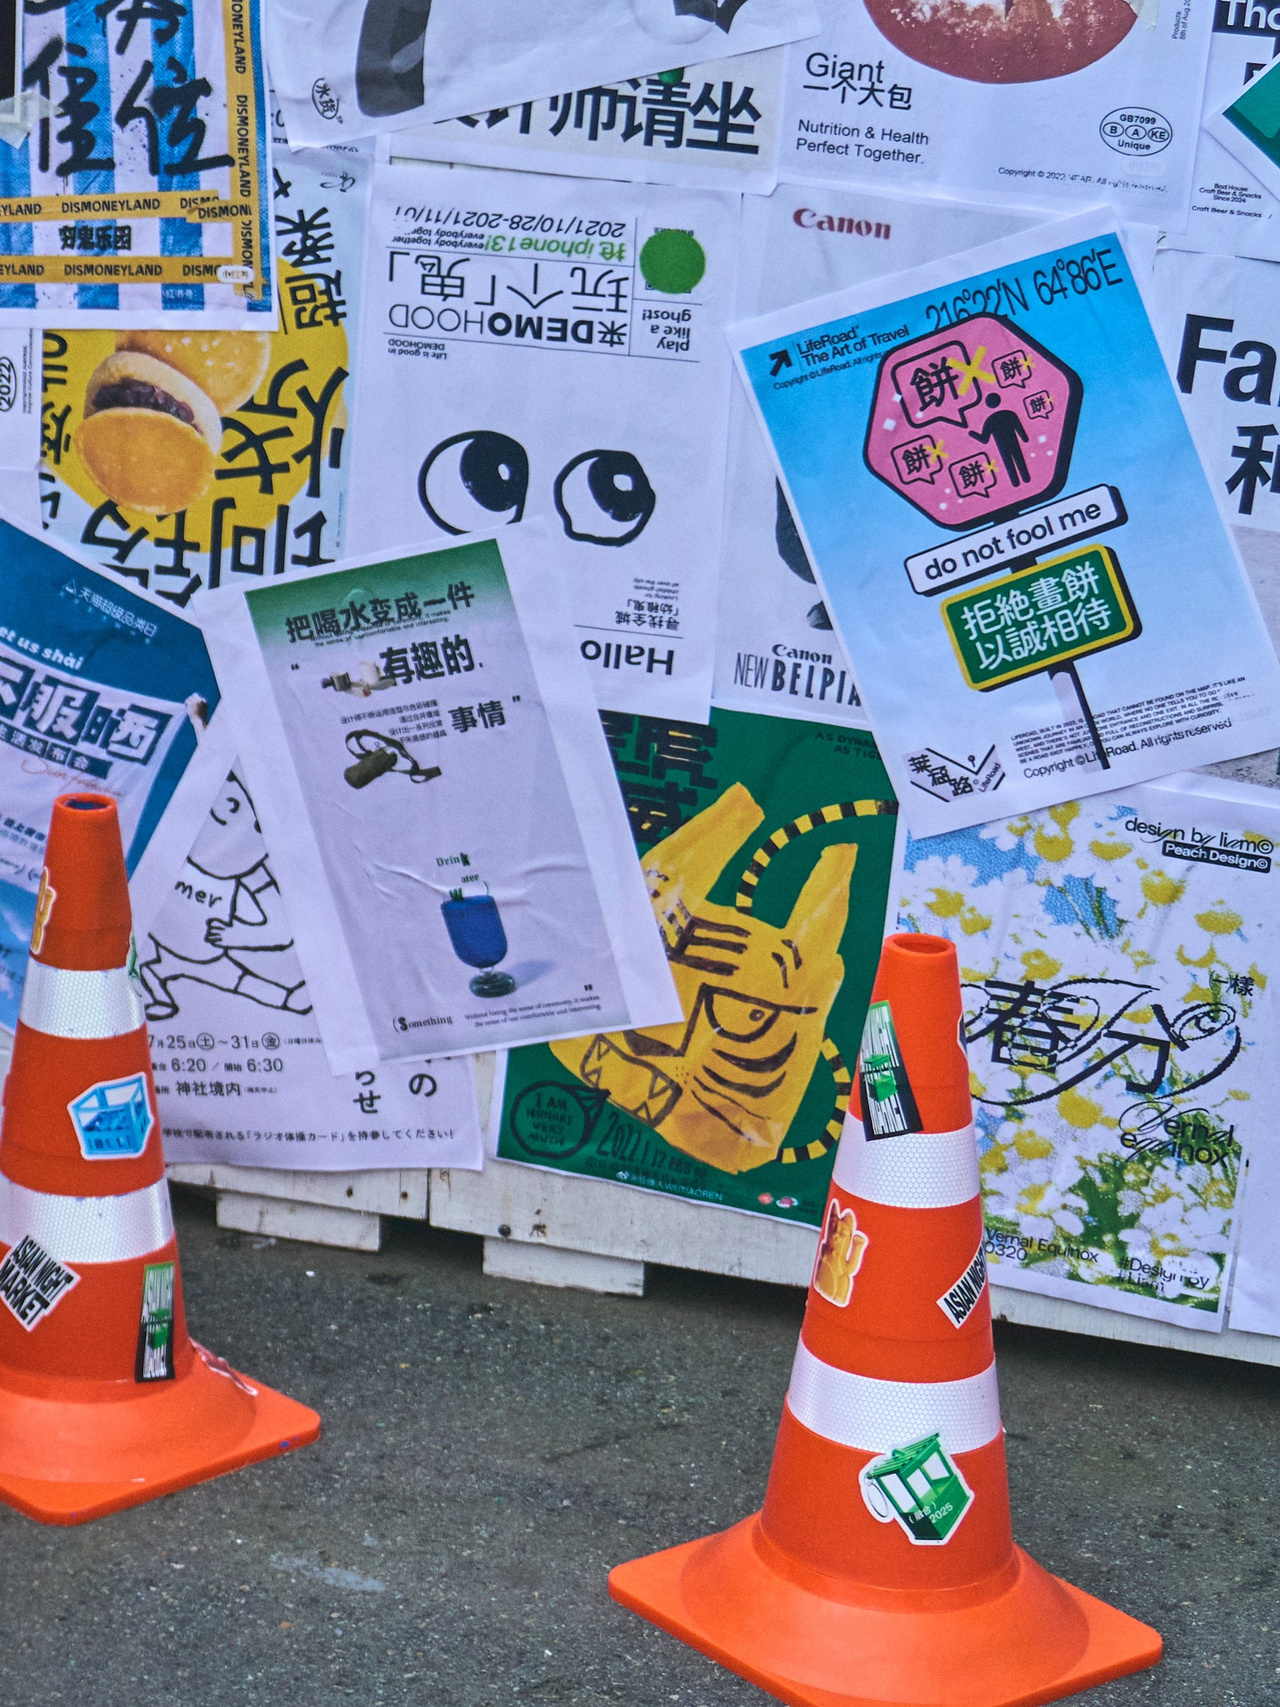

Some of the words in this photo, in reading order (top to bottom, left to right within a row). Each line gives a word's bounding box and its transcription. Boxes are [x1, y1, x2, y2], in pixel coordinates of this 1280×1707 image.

[1182, 8, 1191, 21] Aug
[804, 52, 884, 84] Giant
[802, 79, 913, 111] 一个大包
[1119, 113, 1157, 125] GB7099
[797, 119, 859, 138] Nutrition
[865, 127, 875, 140] &
[880, 128, 930, 146] Health
[1109, 125, 1117, 134] B
[1131, 128, 1140, 137] A
[1150, 130, 1166, 140] KE
[236, 94, 252, 198] DISMONEYLAND
[796, 138, 849, 156] Perfect
[853, 144, 925, 165] Together.
[1118, 139, 1151, 151] Unique
[998, 166, 1035, 179] Copyright
[61, 199, 160, 214] DISMONEYLAND
[1239, 191, 1262, 199] Snacks
[792, 207, 892, 241] Canon
[1236, 210, 1262, 218] Snacks
[392, 234, 431, 247] together
[433, 236, 484, 251] everybody
[435, 227, 484, 241] everybody
[64, 264, 162, 277] DISMONEYLAND
[386, 250, 630, 314] 玩个「鬼」
[387, 302, 628, 348] 来DEMOHOOD
[641, 307, 691, 324] ghost!
[650, 325, 659, 335] a
[661, 326, 690, 339] like
[387, 338, 445, 350] DEMOHOOD
[399, 347, 420, 357] good
[422, 349, 429, 358] is
[430, 350, 447, 360] Life
[656, 336, 690, 352] play
[801, 352, 830, 367] The
[831, 345, 852, 359] Art
[853, 339, 868, 352] of
[868, 324, 909, 346] Travel
[999, 351, 1024, 382] 餅
[1176, 313, 1280, 406] Fa
[773, 373, 808, 390] Copyright
[909, 356, 959, 412] 餅
[901, 445, 931, 475] 餅
[958, 460, 985, 489] 餅
[924, 555, 958, 581] do
[962, 537, 1002, 568] not
[1006, 520, 1055, 551] fool
[1060, 502, 1102, 530] me
[78, 586, 158, 637] 天猫超级品类日
[285, 580, 475, 644] 把喝水变成一件
[626, 599, 679, 616] 「幼稚鬼」
[614, 610, 680, 631] 寻找全城
[16, 633, 40, 655] us
[974, 598, 1112, 672] 以誠相待
[579, 639, 674, 676] Hallo
[771, 644, 833, 665] Canon
[733, 652, 766, 689] NEW
[448, 700, 505, 734] 事情
[1022, 756, 1076, 782] Copyright
[1139, 737, 1154, 749] All
[1124, 818, 1185, 844] design
[1190, 828, 1215, 850] by
[436, 852, 471, 869] Drink
[1165, 843, 1207, 859] Peach
[174, 879, 222, 909] mer
[464, 1011, 488, 1020] Without
[489, 1008, 507, 1018] losing
[518, 1004, 534, 1012] sense
[580, 994, 600, 1003] makes
[485, 1017, 500, 1026] sense
[520, 1009, 555, 1020] comfortable
[569, 1002, 601, 1014] interesting.
[171, 1057, 207, 1073] 6:20
[246, 1057, 284, 1073] 6:30
[175, 1080, 241, 1097] 神社境内
[409, 1073, 437, 1098] の
[1119, 1100, 1235, 1148] Vernal
[1120, 1132, 1230, 1169] equinox
[985, 1228, 1033, 1249] Vernal
[1038, 1238, 1100, 1263] Equinox
[985, 1240, 1028, 1262] 0320
[9, 1234, 47, 1279] ASIAN
[31, 1257, 74, 1301] NIGHT
[943, 1276, 977, 1324] ASIAN
[929, 1502, 953, 1523] 2025
